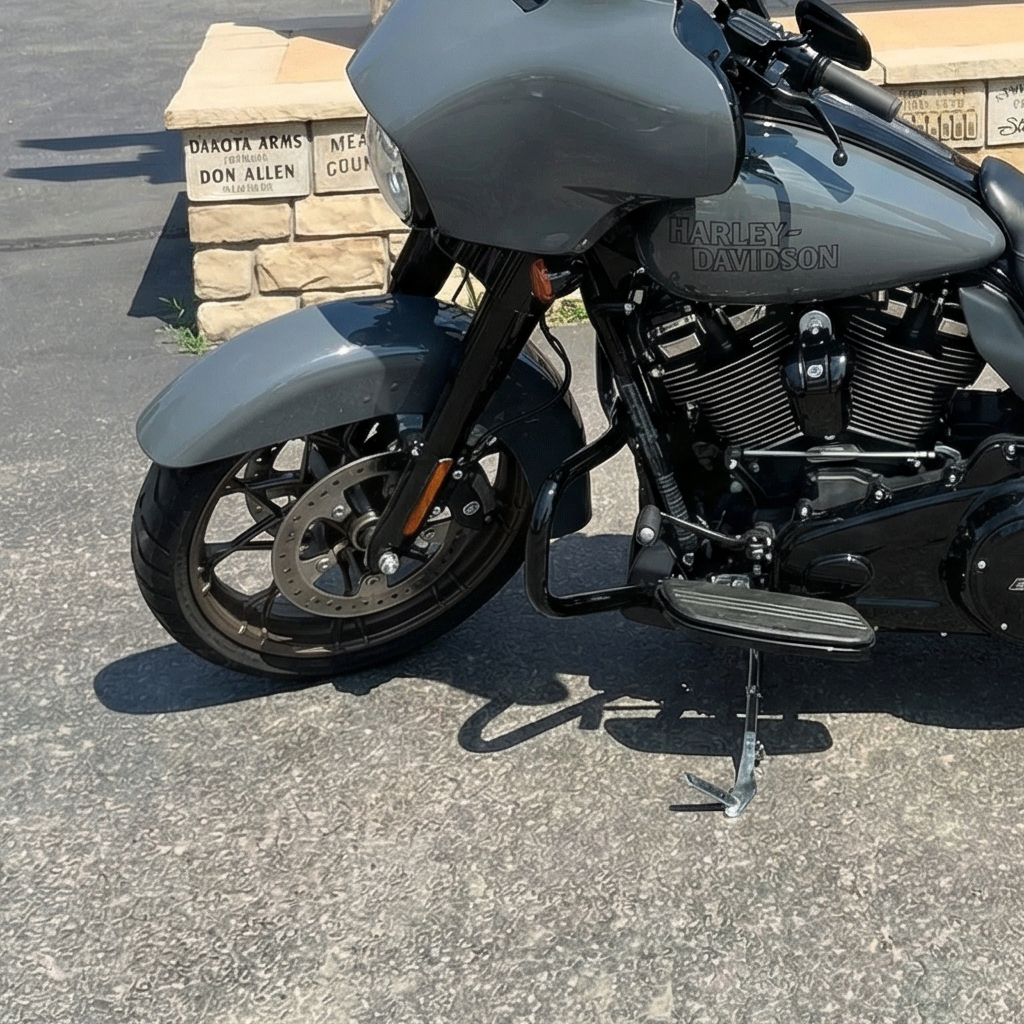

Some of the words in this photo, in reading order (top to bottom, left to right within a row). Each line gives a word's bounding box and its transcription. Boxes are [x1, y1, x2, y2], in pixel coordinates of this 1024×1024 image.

[258, 134, 303, 150] ARMS
[199, 167, 236, 184] DON
[244, 164, 295, 182] ALLEN
[668, 216, 803, 247] HARLEY-
[691, 244, 839, 272] DAVIDSON
